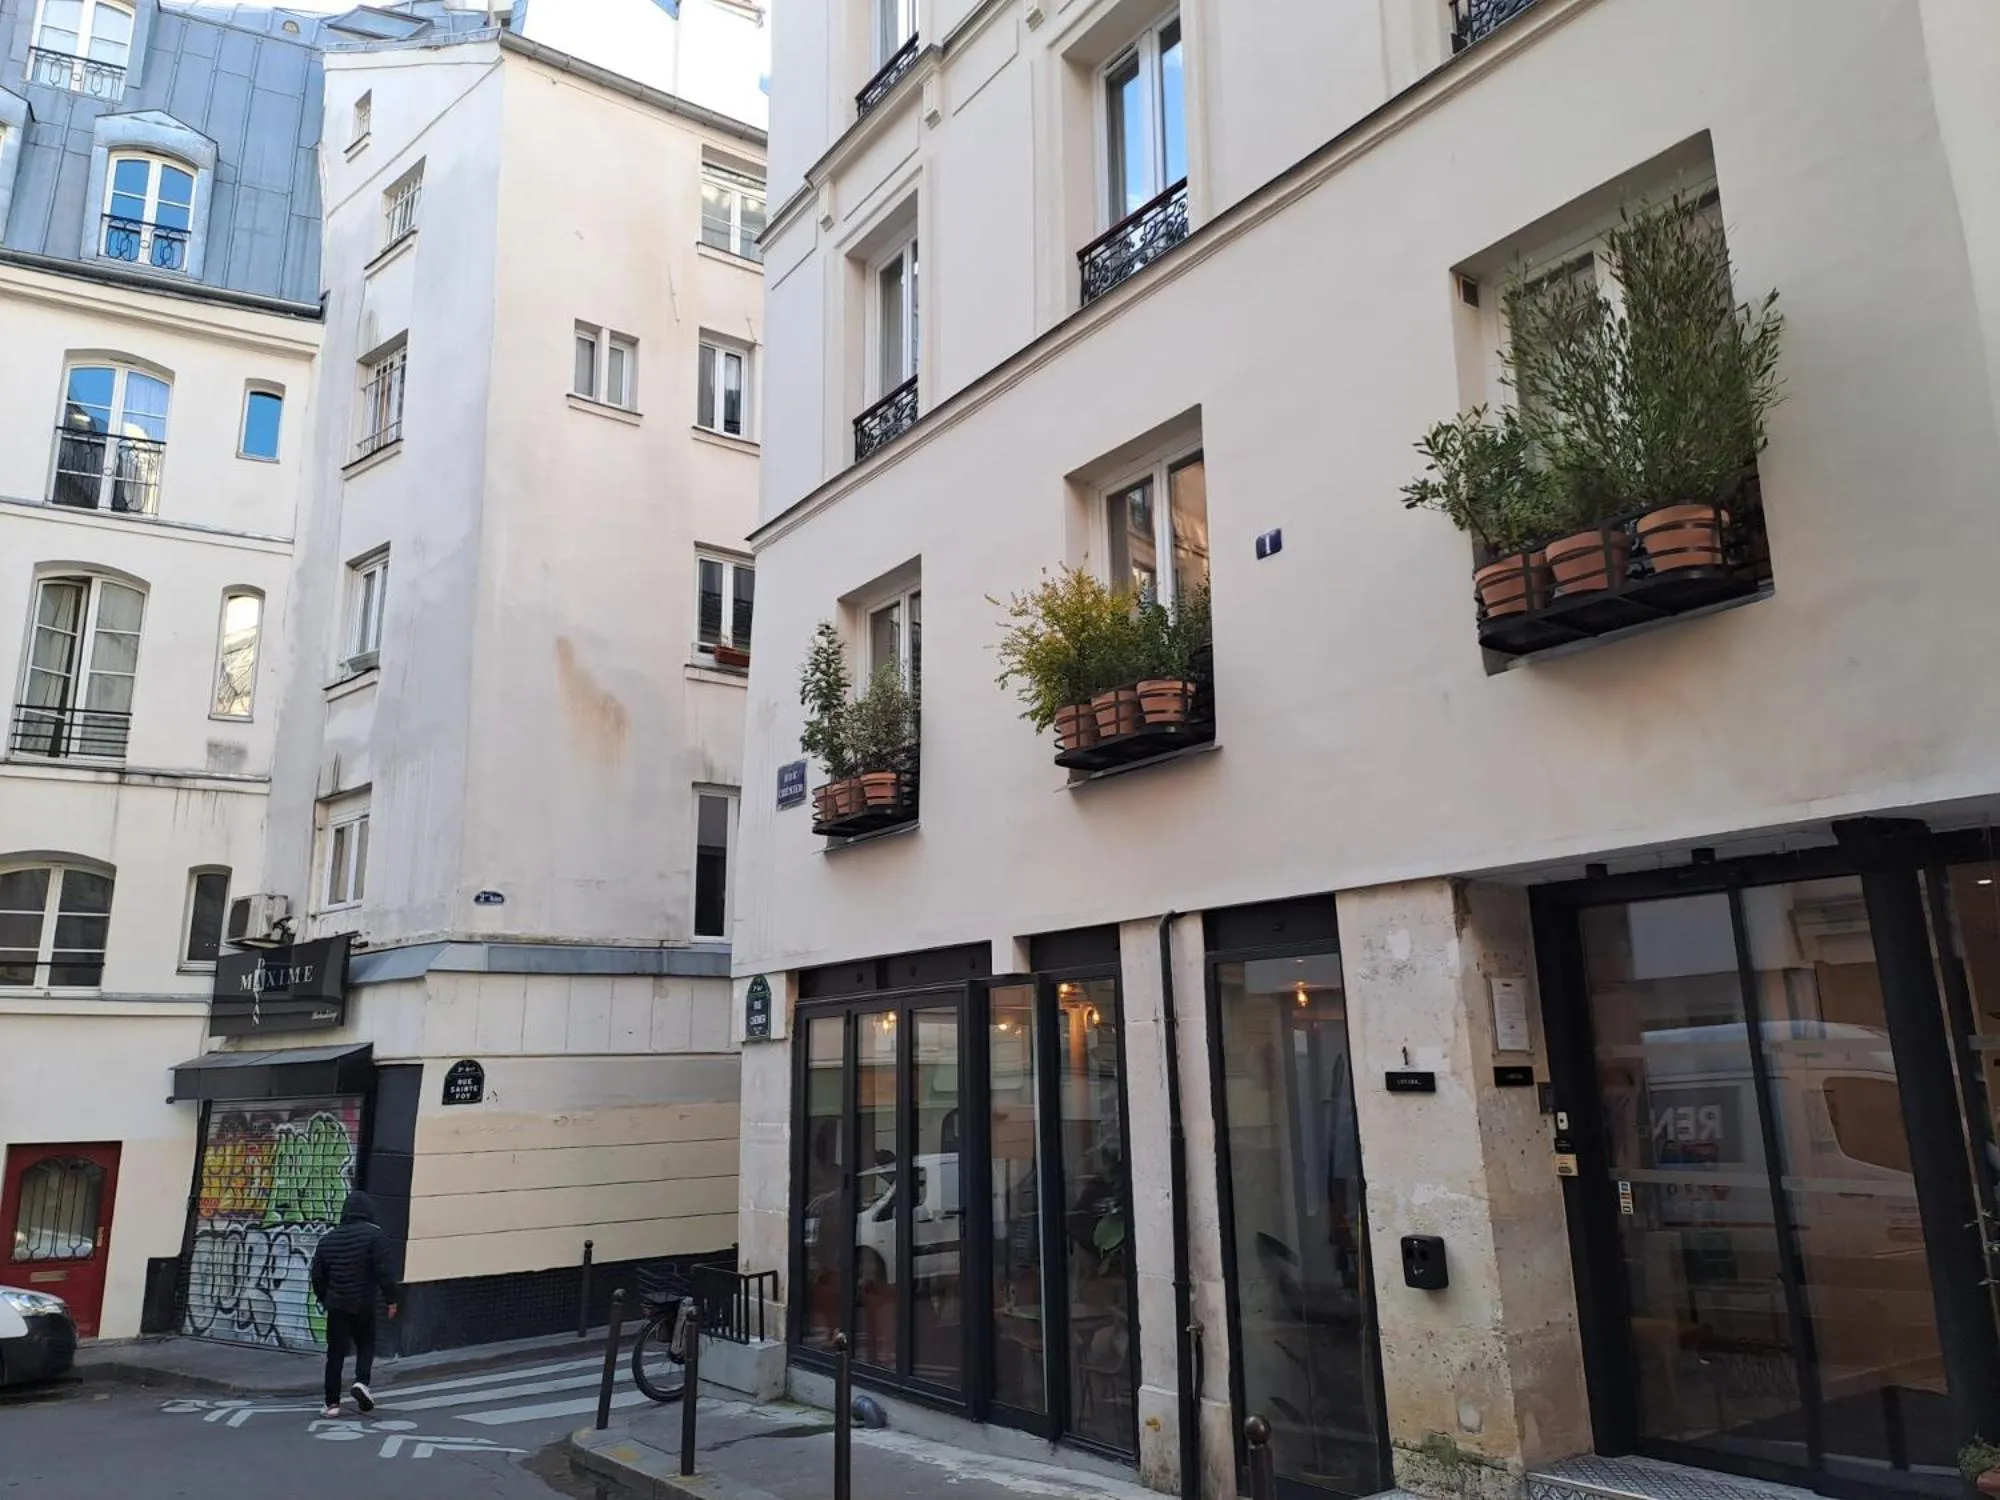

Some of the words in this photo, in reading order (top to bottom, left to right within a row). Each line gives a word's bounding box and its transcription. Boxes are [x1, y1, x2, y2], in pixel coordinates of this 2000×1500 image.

[1264, 534, 1271, 554] 1
[239, 964, 314, 992] MAXIME
[450, 1085, 479, 1094] SAINTE
[456, 1092, 471, 1100] FOY
